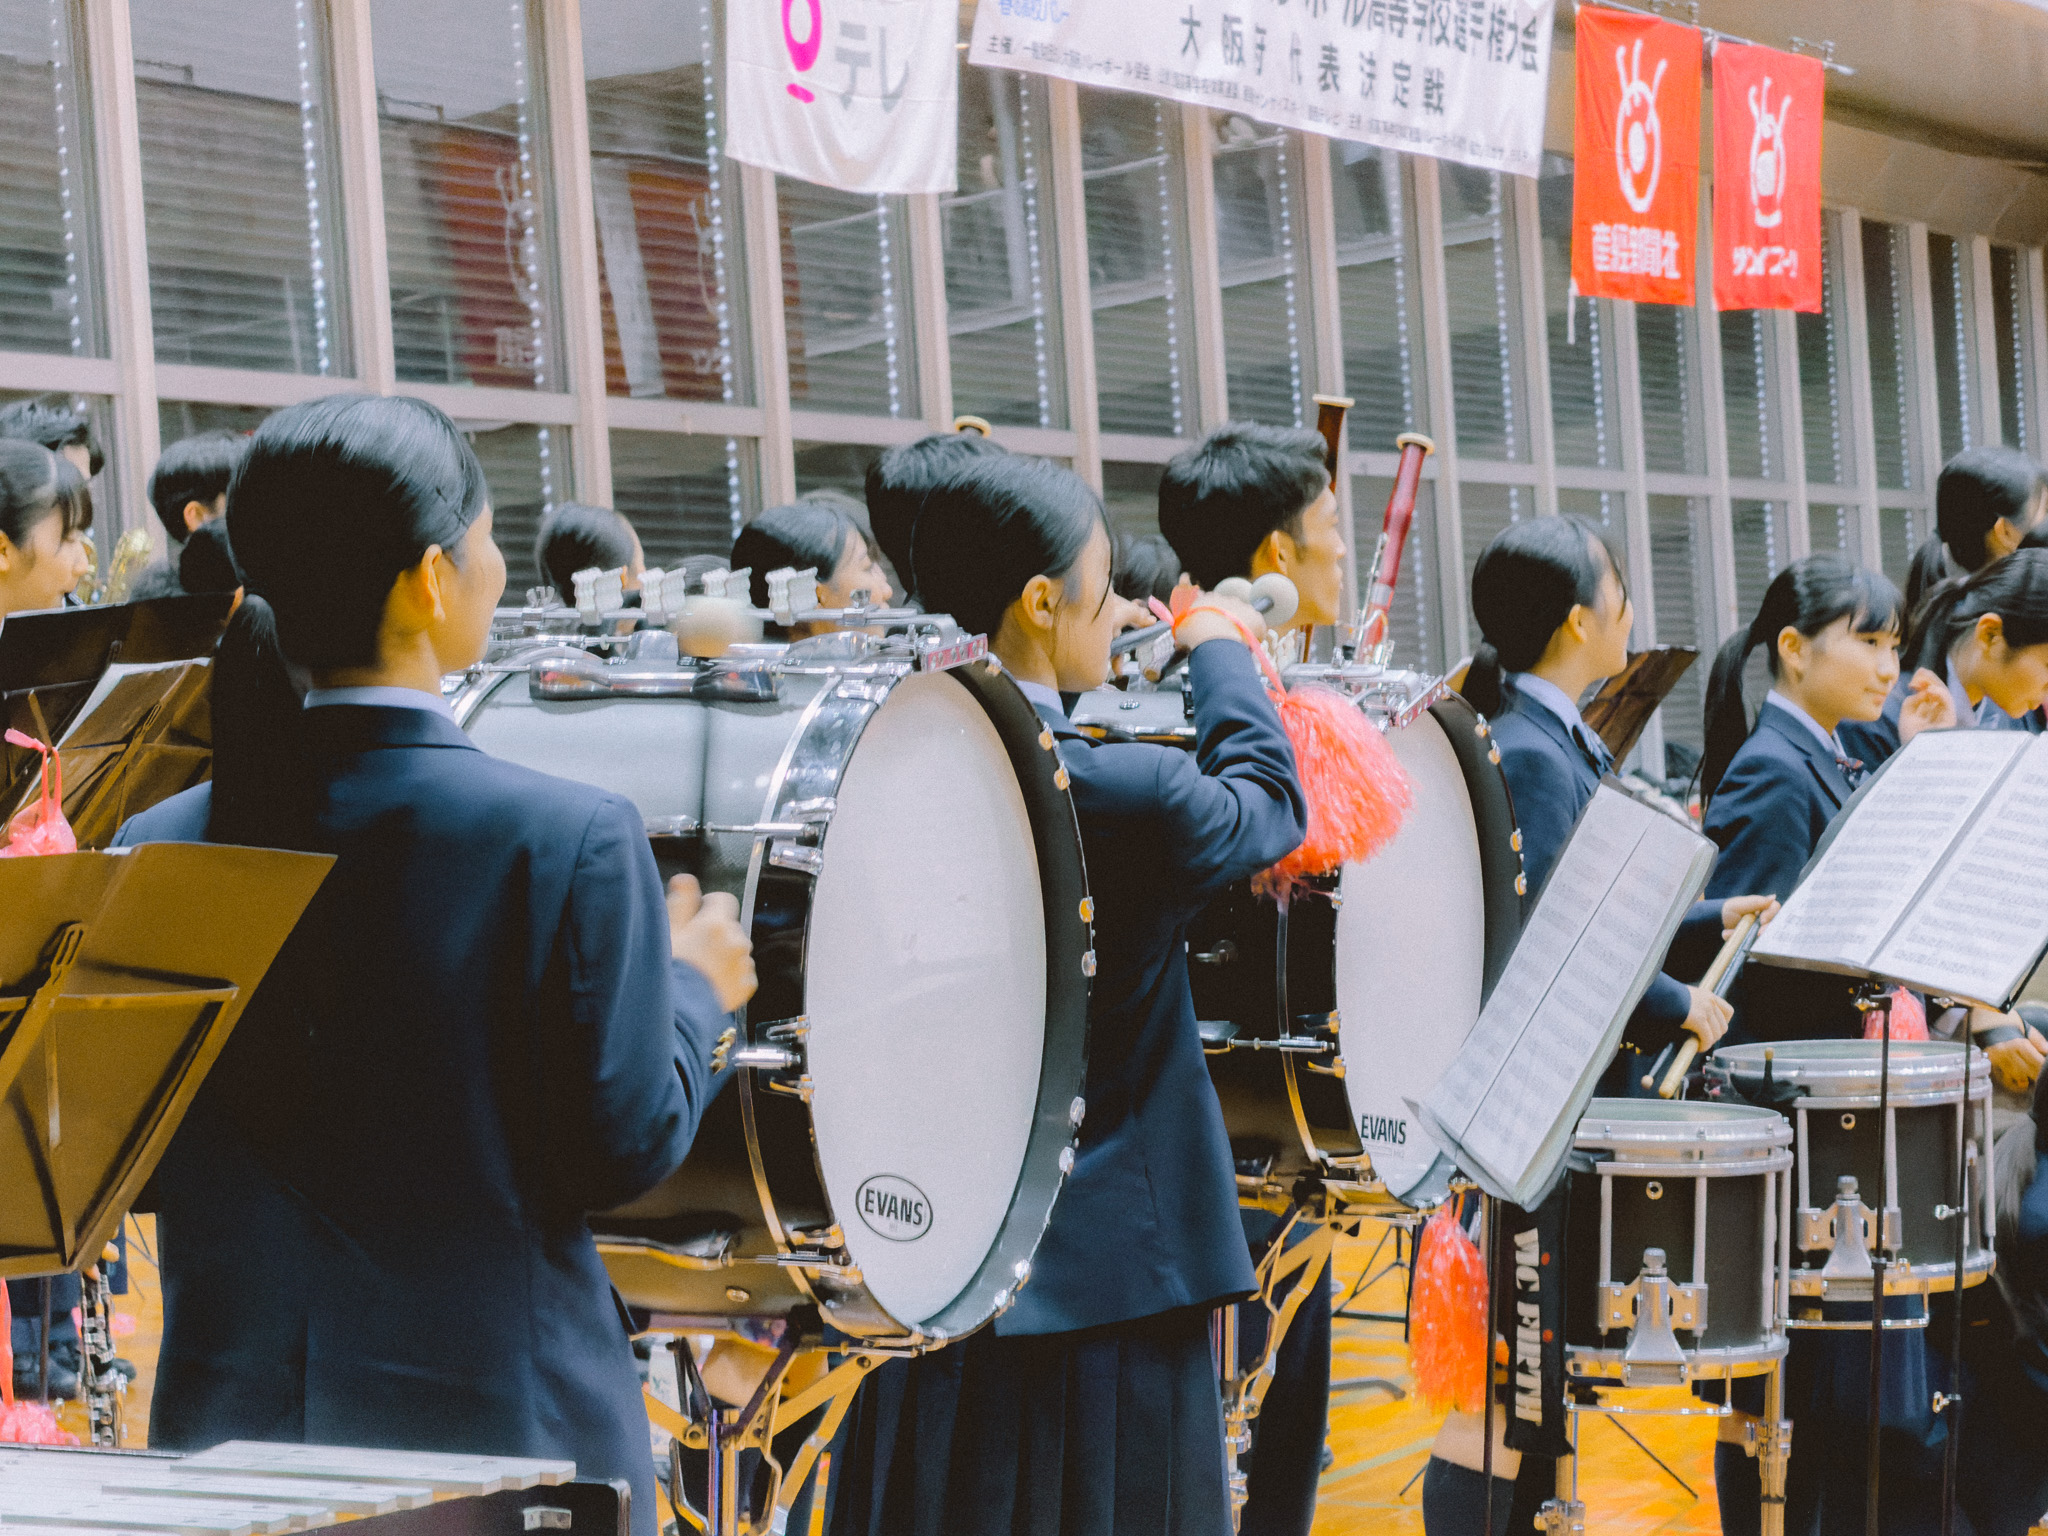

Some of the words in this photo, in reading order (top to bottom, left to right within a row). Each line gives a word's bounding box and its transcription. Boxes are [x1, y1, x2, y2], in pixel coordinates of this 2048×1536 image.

[835, 20, 909, 113] テレ
[1361, 1113, 1407, 1145] EVANS
[864, 1187, 924, 1226] EVANS
[1513, 1227, 1551, 1293] VIC
[1516, 1301, 1554, 1427] FIRTH
